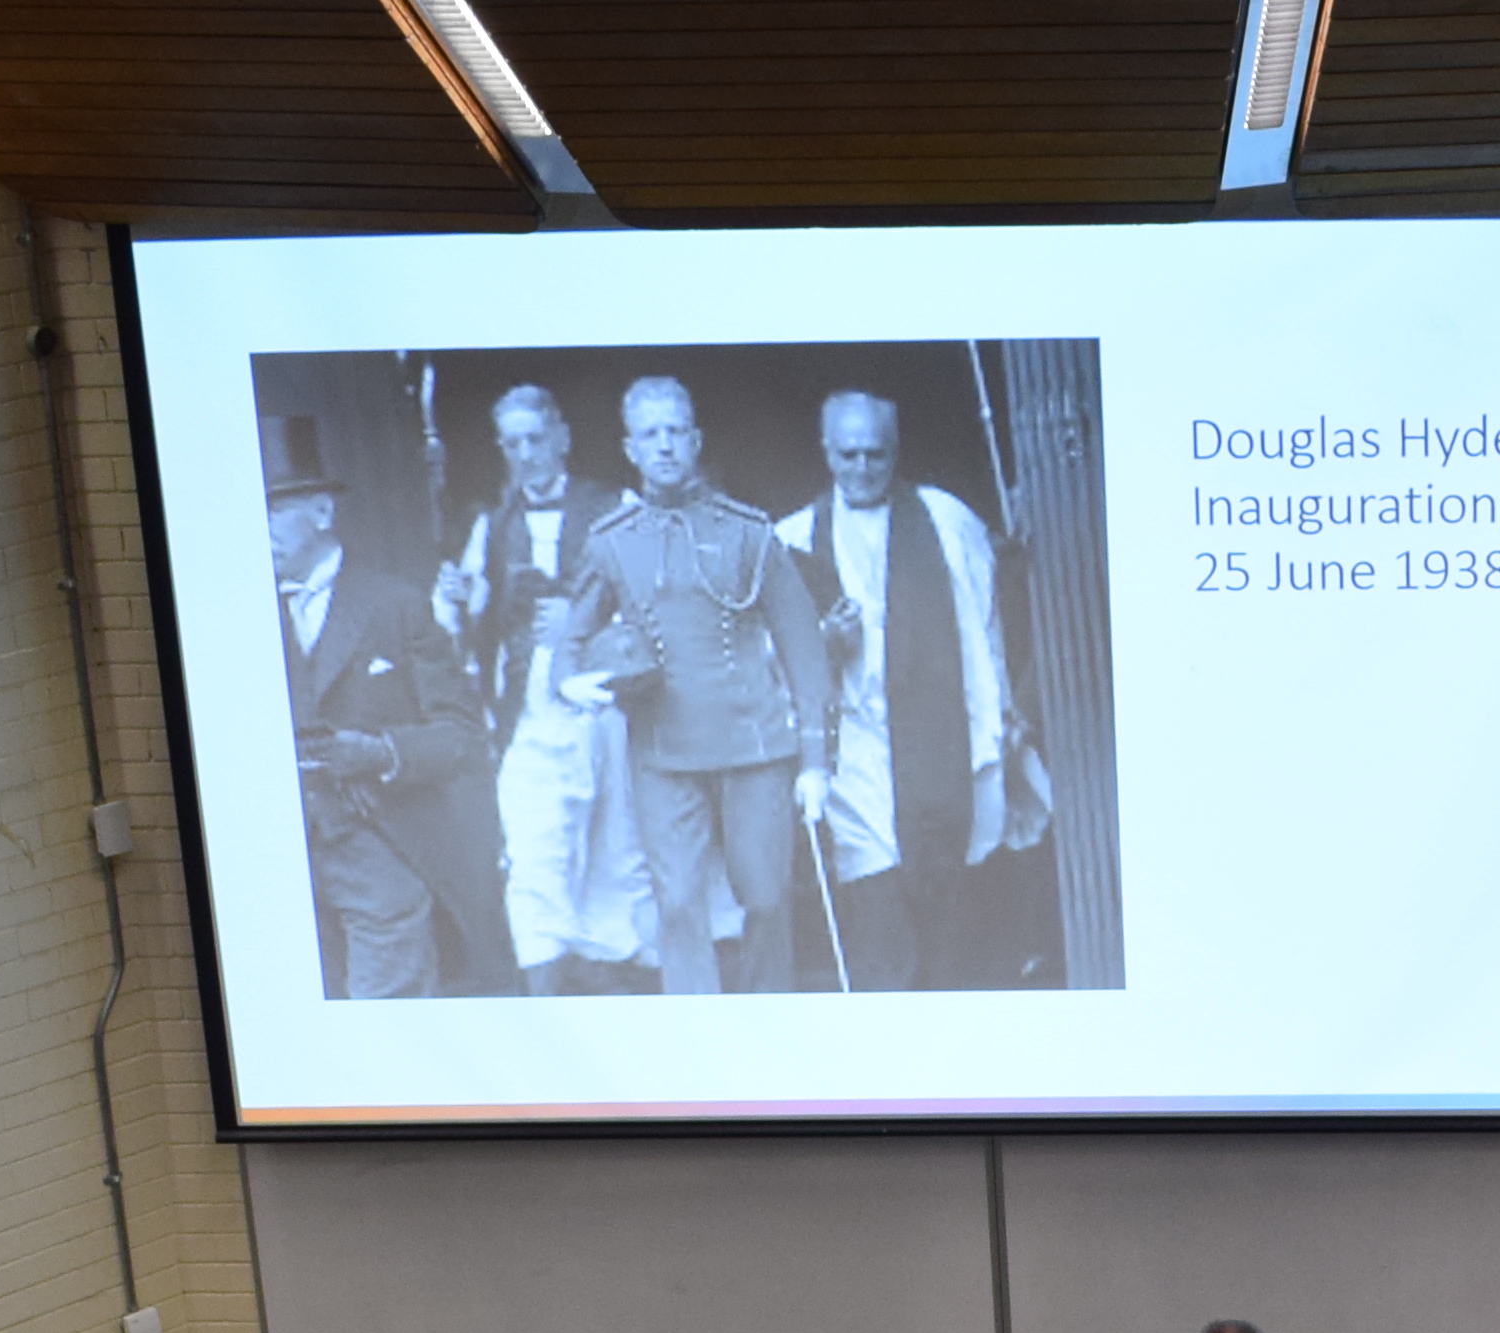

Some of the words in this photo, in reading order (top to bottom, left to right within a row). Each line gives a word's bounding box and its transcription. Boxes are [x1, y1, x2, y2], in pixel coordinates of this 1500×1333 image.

[1191, 414, 1381, 469] Douglas
[1194, 552, 1250, 592] 25
[1267, 552, 1376, 591] June
